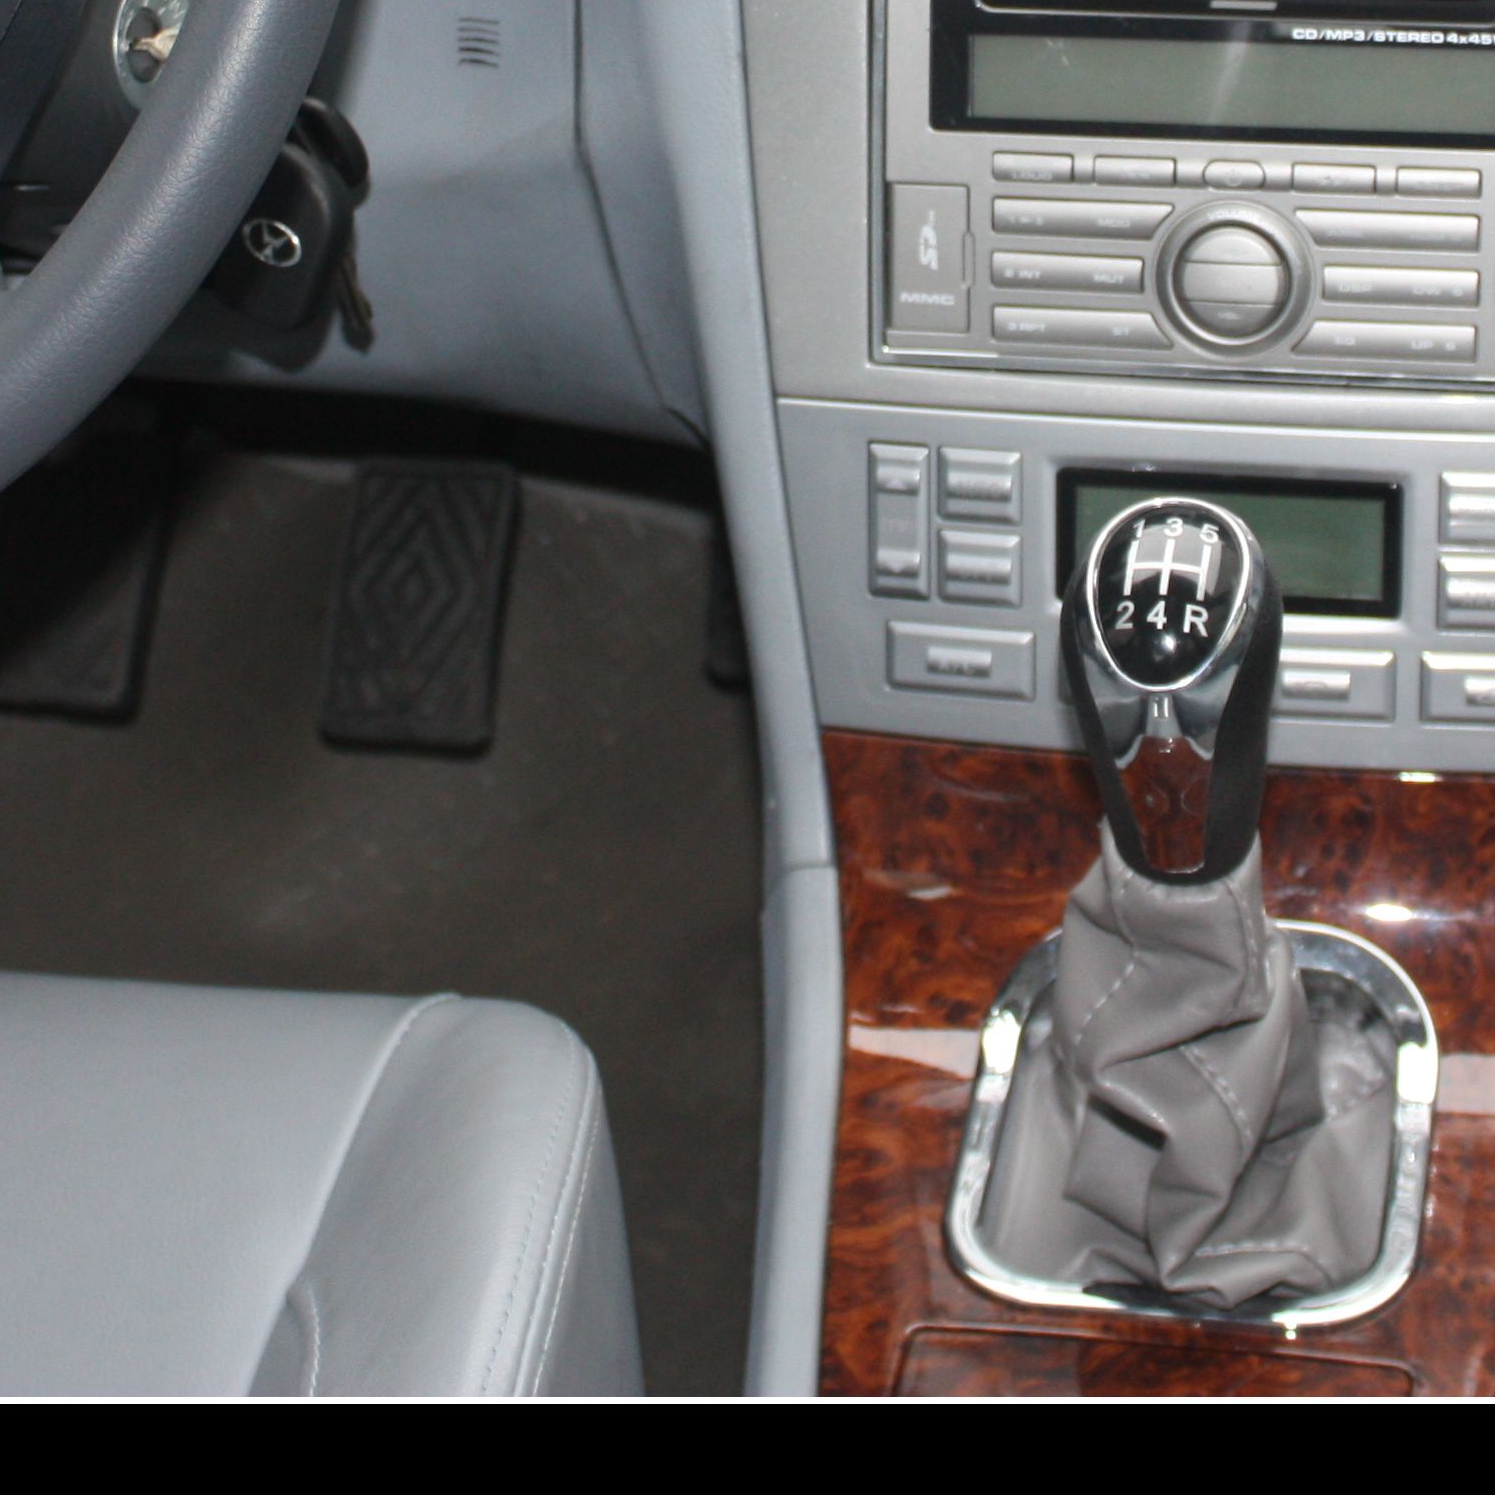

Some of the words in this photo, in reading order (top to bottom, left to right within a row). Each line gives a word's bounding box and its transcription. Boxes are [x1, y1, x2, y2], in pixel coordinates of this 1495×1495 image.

[1291, 27, 1445, 44] CD/MP3/STEREO
[1132, 518, 1147, 539] 1
[1163, 517, 1184, 538] 3
[1199, 522, 1220, 545] 5
[1115, 601, 1136, 630] 2
[1146, 600, 1169, 630] 4
[1183, 604, 1210, 638] R
